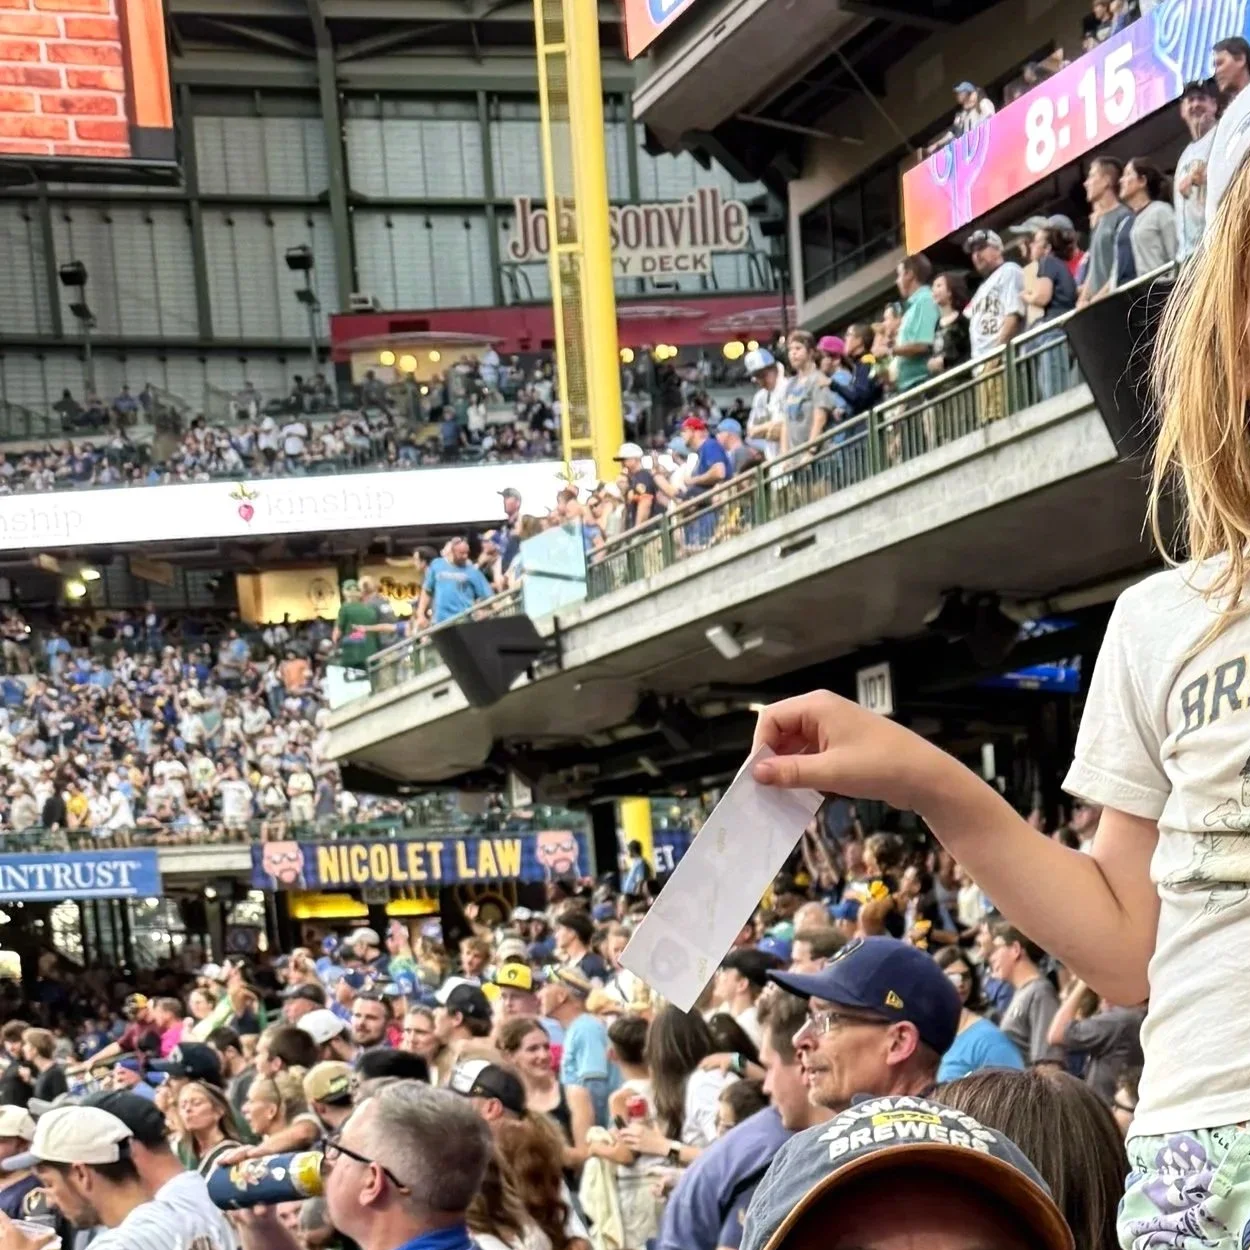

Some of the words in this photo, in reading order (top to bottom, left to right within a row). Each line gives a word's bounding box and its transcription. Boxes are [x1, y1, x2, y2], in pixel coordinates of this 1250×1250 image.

[1025, 41, 1136, 173] 8:15
[641, 253, 708, 273] DECK
[266, 486, 395, 520] kinship
[316, 842, 444, 883] NICOLET
[456, 838, 522, 878] LAW
[829, 1121, 990, 1161] BREWERS
